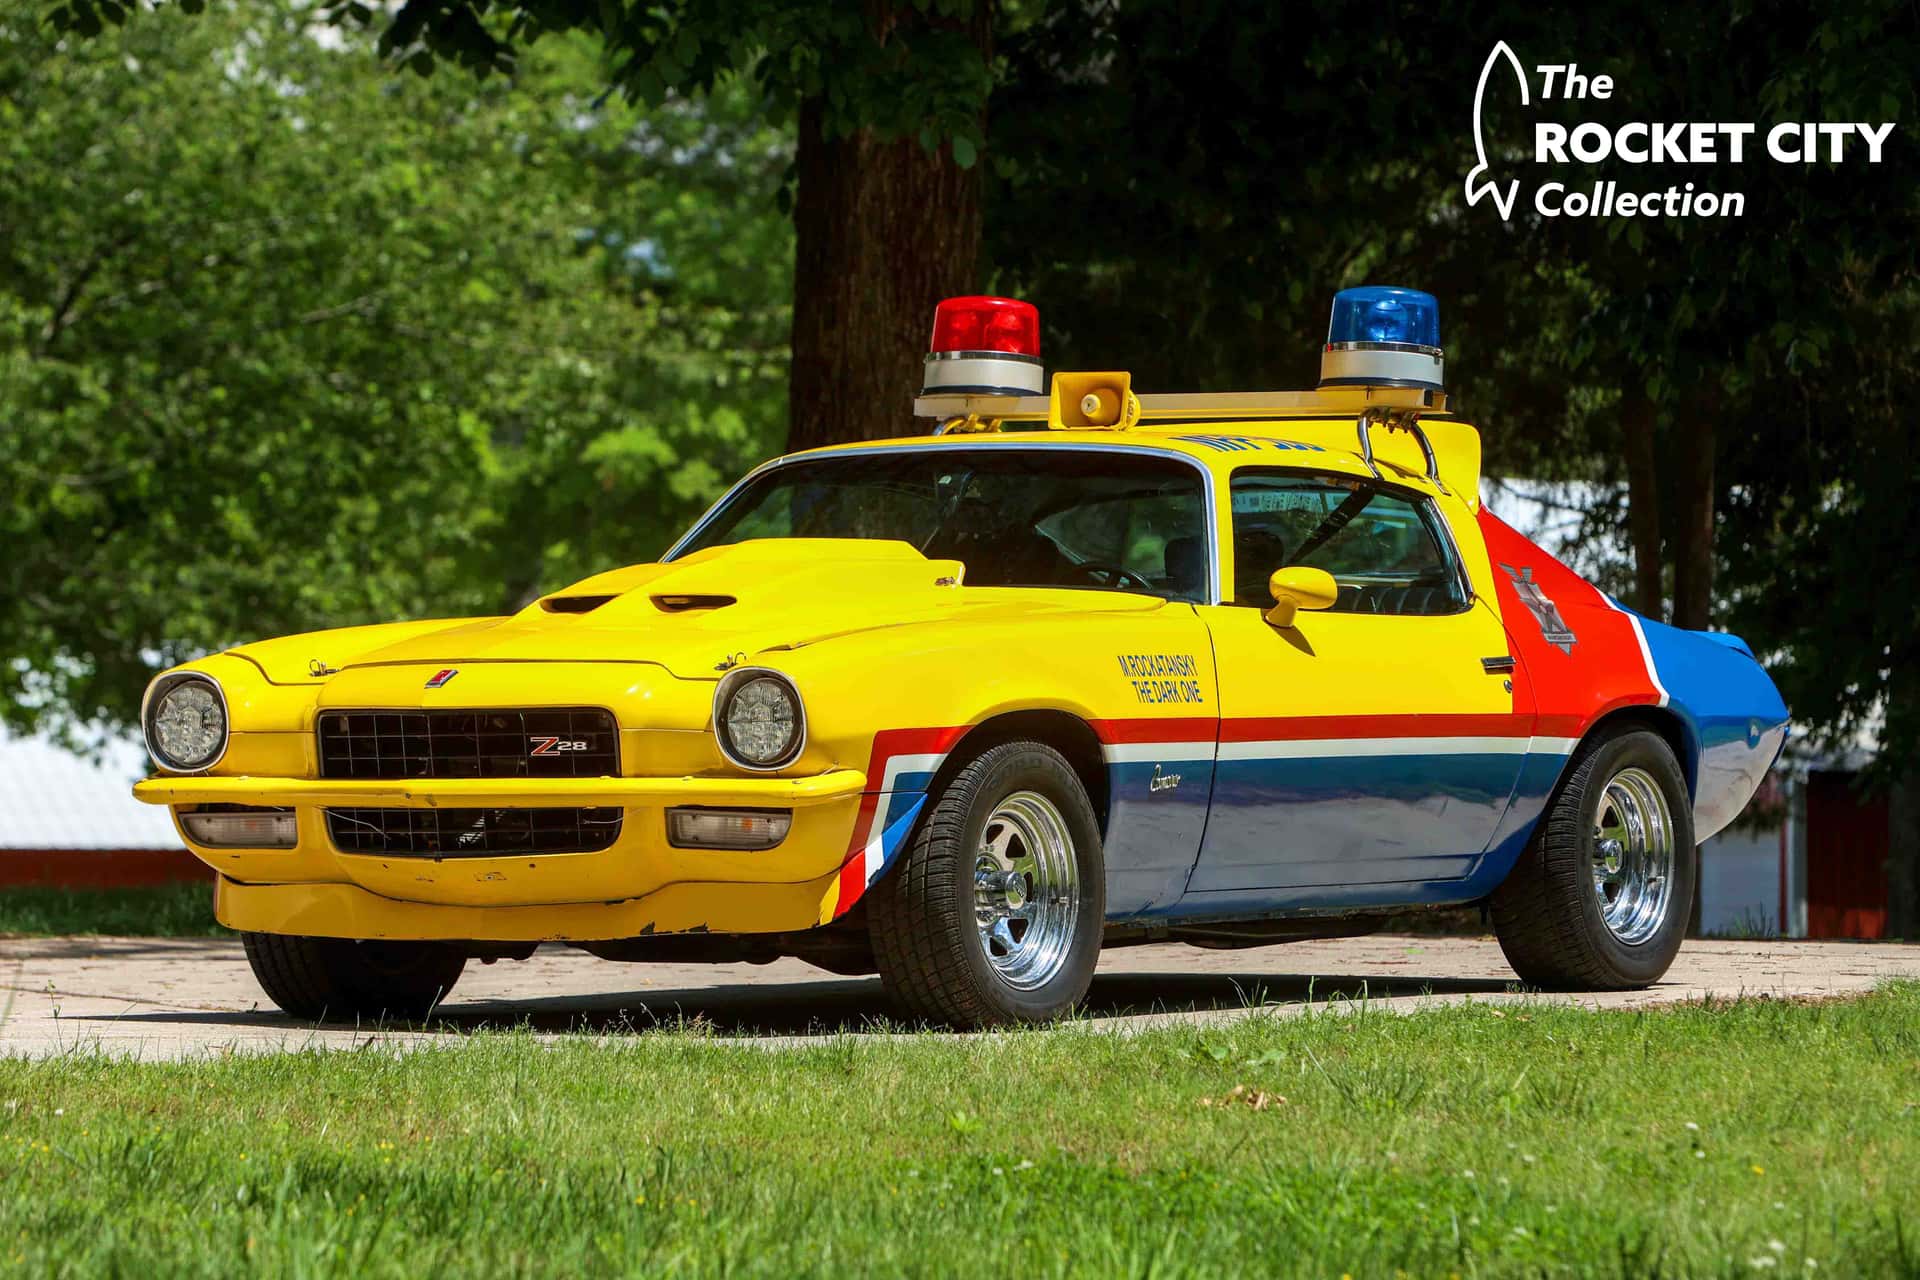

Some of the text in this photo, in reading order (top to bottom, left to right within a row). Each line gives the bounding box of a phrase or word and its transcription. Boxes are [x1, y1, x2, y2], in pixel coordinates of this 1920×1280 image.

[1117, 655, 1198, 677] M.ROCKATANSKY
[1132, 681, 1203, 703] THE DARK ONE
[530, 736, 587, 756] Z28
